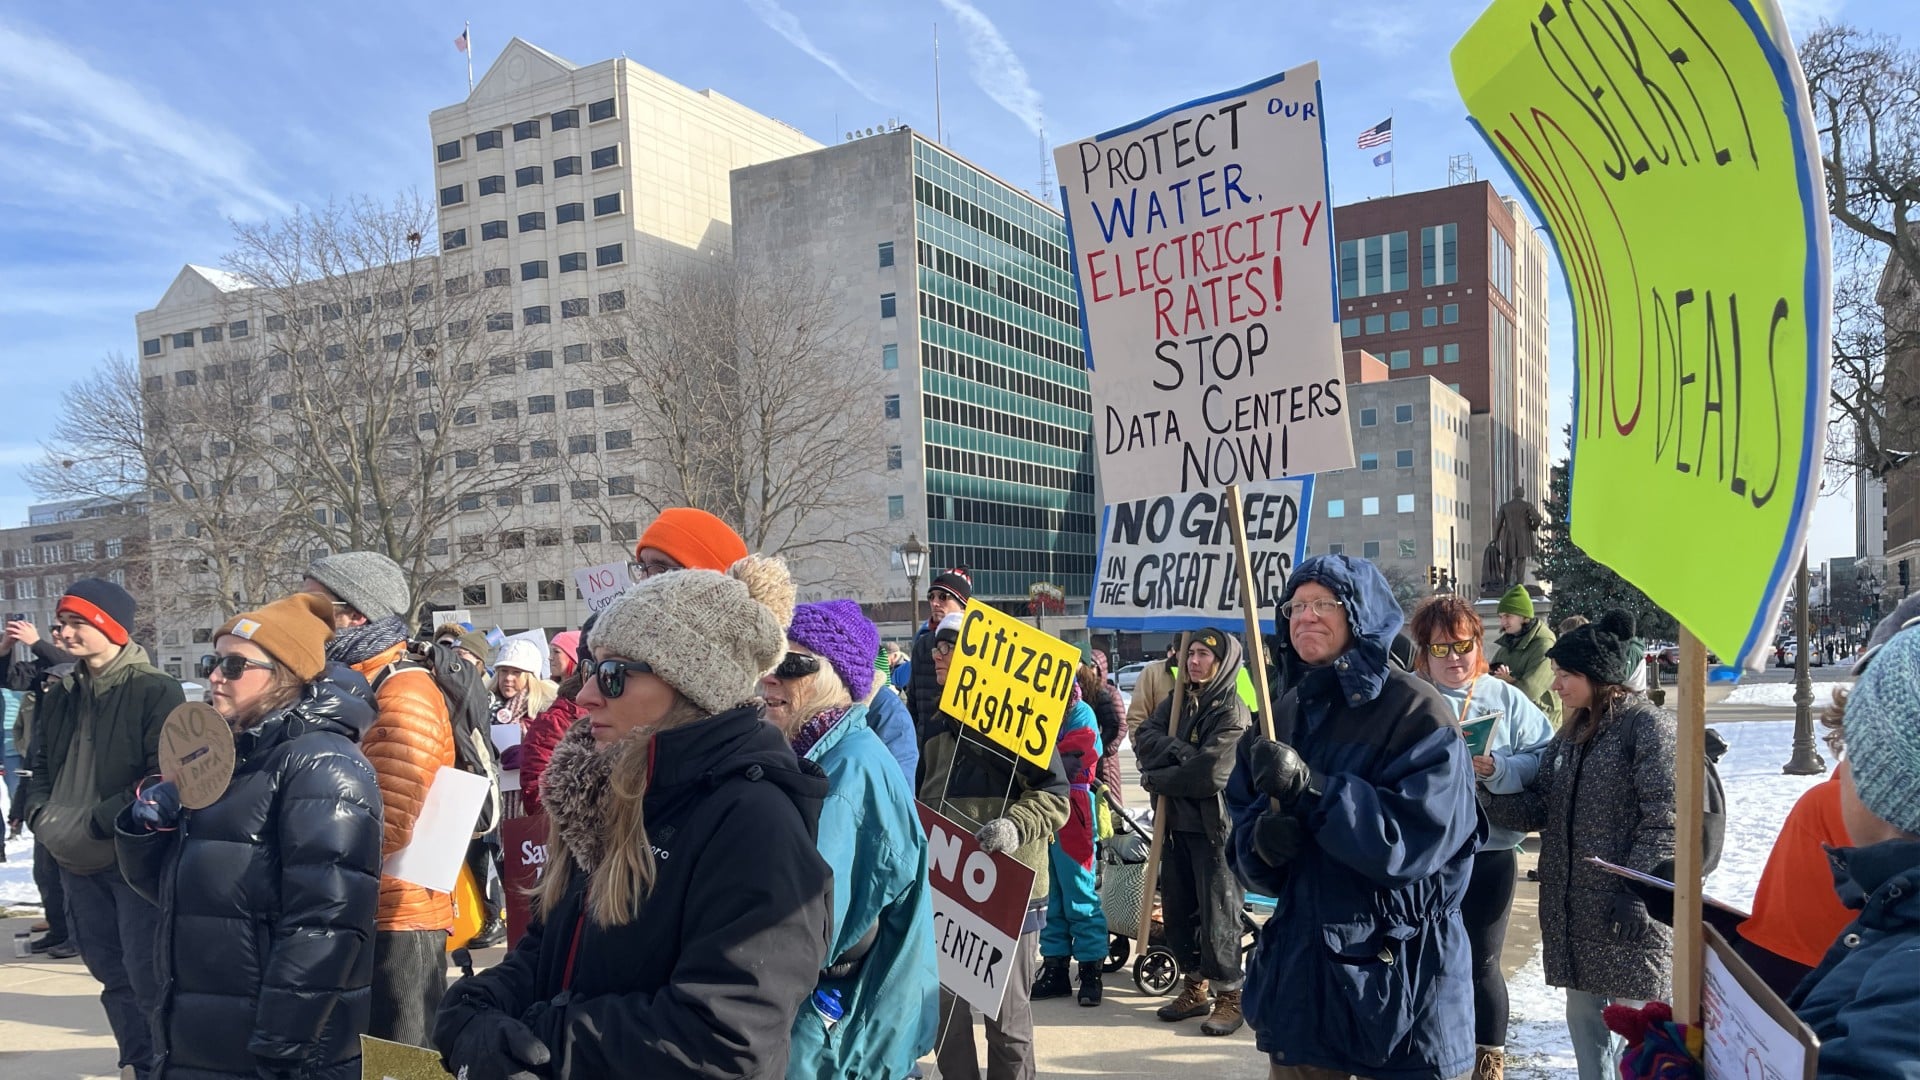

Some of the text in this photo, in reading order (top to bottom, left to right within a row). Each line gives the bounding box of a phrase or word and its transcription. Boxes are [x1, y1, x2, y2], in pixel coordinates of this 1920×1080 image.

[1078, 97, 1317, 194] PROTECT OUR
[1087, 200, 1322, 303] ELECTRICITY
[1154, 255, 1283, 340] RATES!
[1494, 107, 1789, 509] NO DEALS
[1153, 323, 1268, 391] STOP
[1105, 404, 1182, 455] DATA
[1202, 378, 1342, 434] CENTERS
[1181, 425, 1289, 493] NOW!
[1111, 495, 1175, 546] NO
[588, 569, 615, 593] NO
[1100, 581, 1130, 606] THE
[1106, 556, 1127, 580] IN
[1132, 551, 1221, 610] GREAT
[961, 609, 1073, 702] Citizen
[165, 708, 206, 756] NO
[952, 665, 1049, 756] Rights
[928, 823, 998, 903] NO
